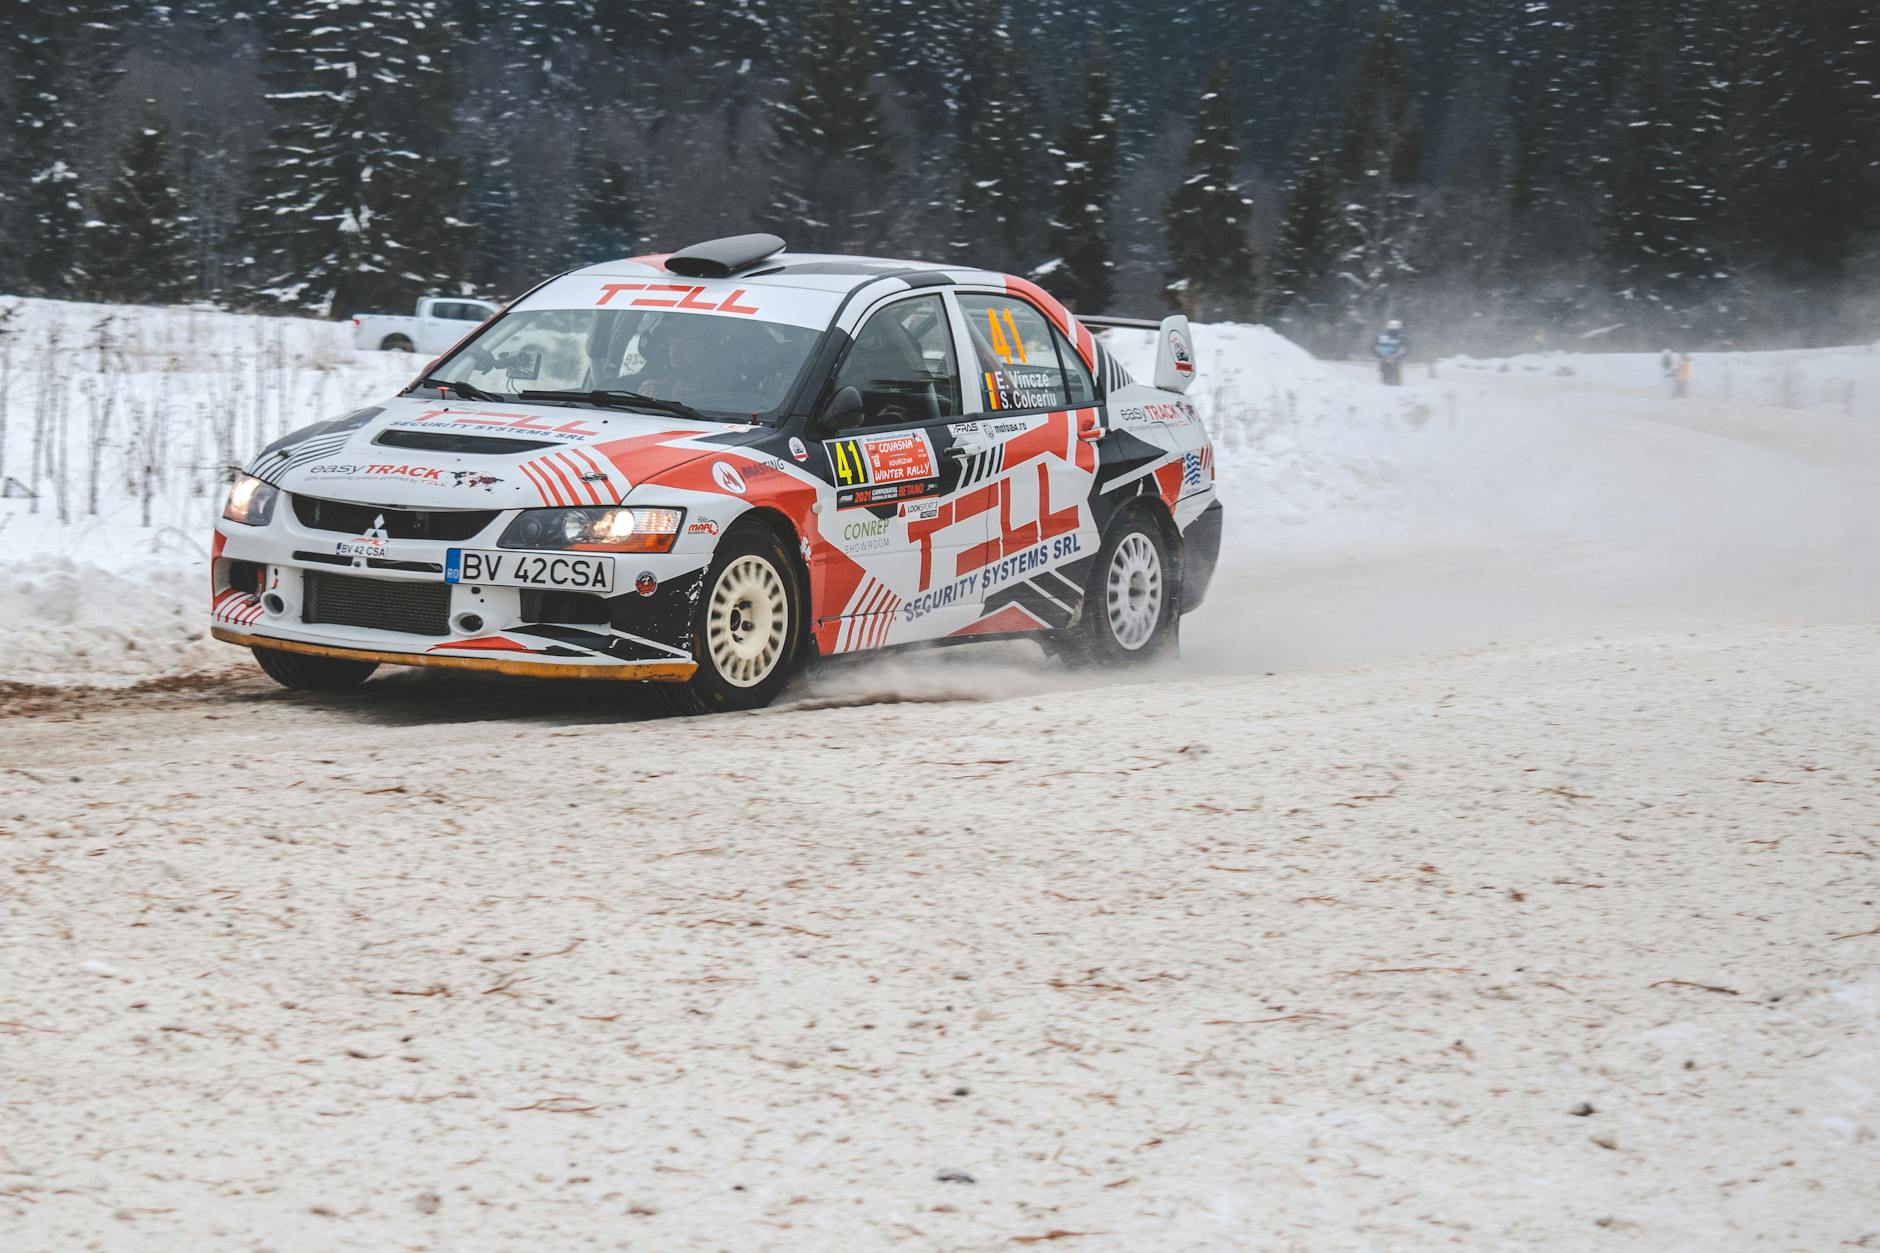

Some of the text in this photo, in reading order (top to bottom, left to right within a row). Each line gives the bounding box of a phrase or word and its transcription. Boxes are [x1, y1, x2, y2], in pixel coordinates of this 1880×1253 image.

[595, 284, 760, 315] TELL
[987, 307, 1027, 365] 41
[995, 370, 1050, 390] E. Vincze
[1000, 389, 1058, 410] S. Colceriu
[414, 410, 600, 437] TELL
[477, 424, 552, 437] SYSTEMS
[555, 432, 586, 442] SRL
[878, 439, 913, 453] COVASNA
[835, 440, 865, 485] 41
[875, 462, 930, 481] WINTER RALLY
[854, 490, 871, 503] 2021
[898, 483, 925, 498] BETANO
[844, 518, 890, 541] CONREP
[908, 462, 1080, 593] TELL
[341, 544, 385, 557] BV 42 CSA
[845, 537, 890, 554] SHOWROOM
[447, 567, 459, 580] RO
[463, 553, 502, 582] BV
[514, 557, 608, 589] 42CSA
[904, 533, 1081, 623] SECURITY SYSTEMS SRL
